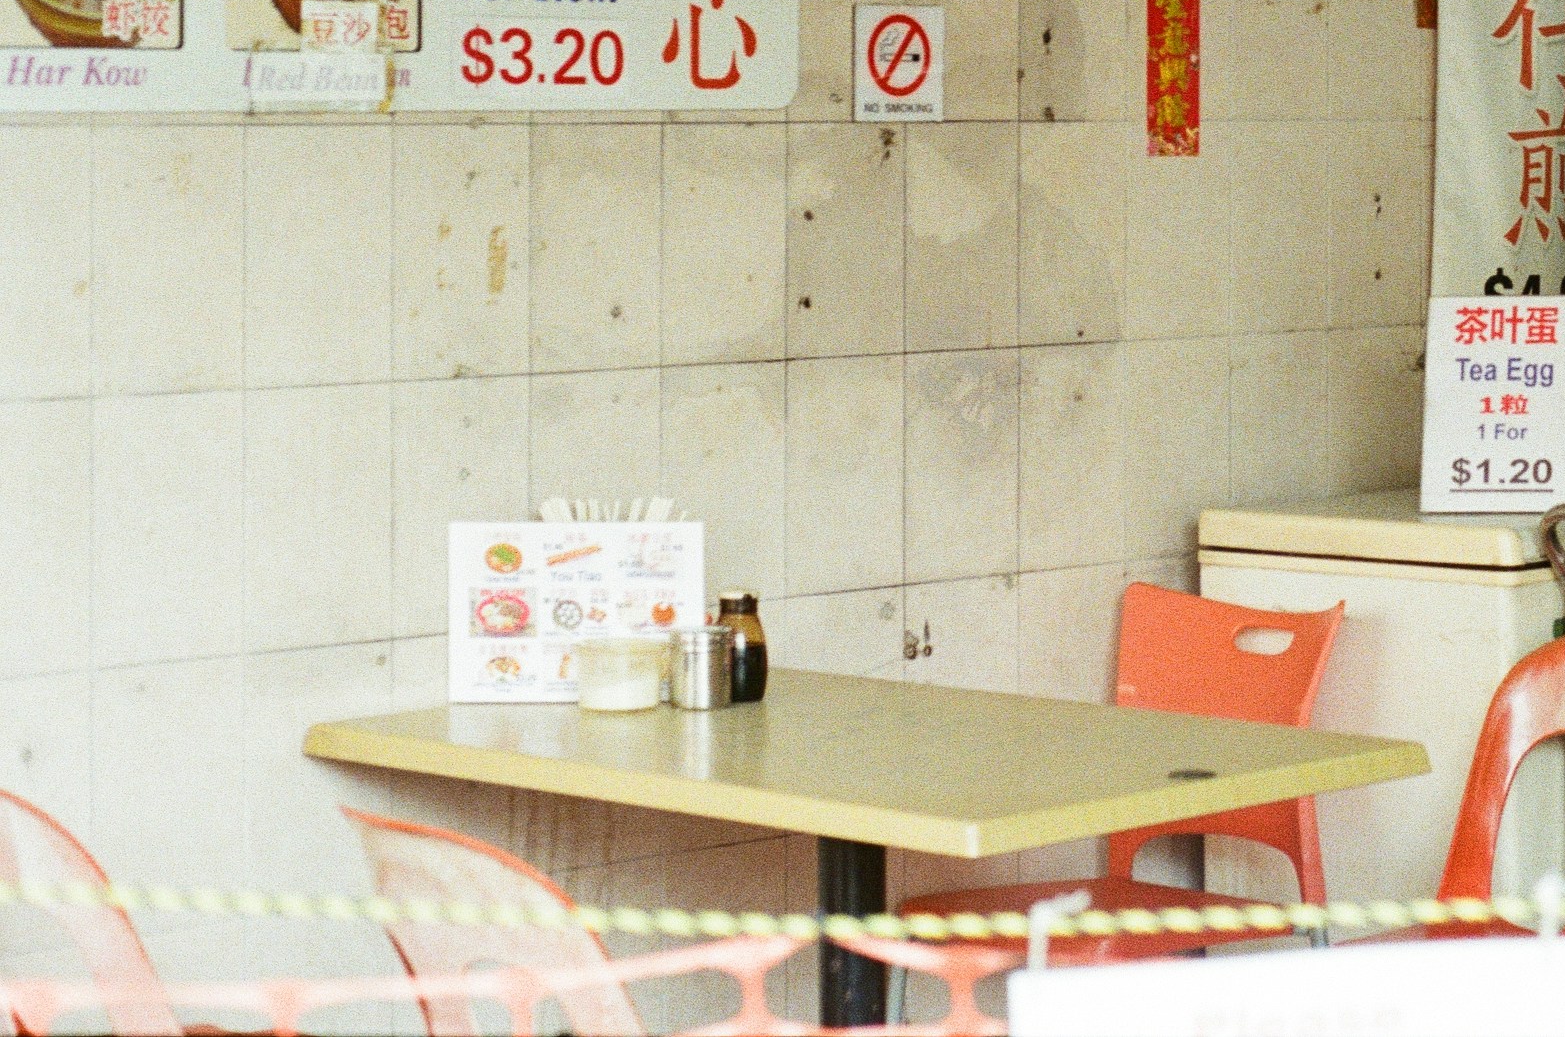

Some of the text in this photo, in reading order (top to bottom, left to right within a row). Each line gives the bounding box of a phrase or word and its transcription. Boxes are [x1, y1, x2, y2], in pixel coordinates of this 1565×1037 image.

[460, 23, 624, 89] $3.20
[7, 57, 148, 87] Har Kow
[1455, 308, 1560, 345] 茶叶蛋
[1455, 358, 1554, 387] Tea Egg
[1480, 394, 1529, 416] 1粒
[1477, 424, 1528, 441] 1 For
[1451, 458, 1554, 486] $1.20
